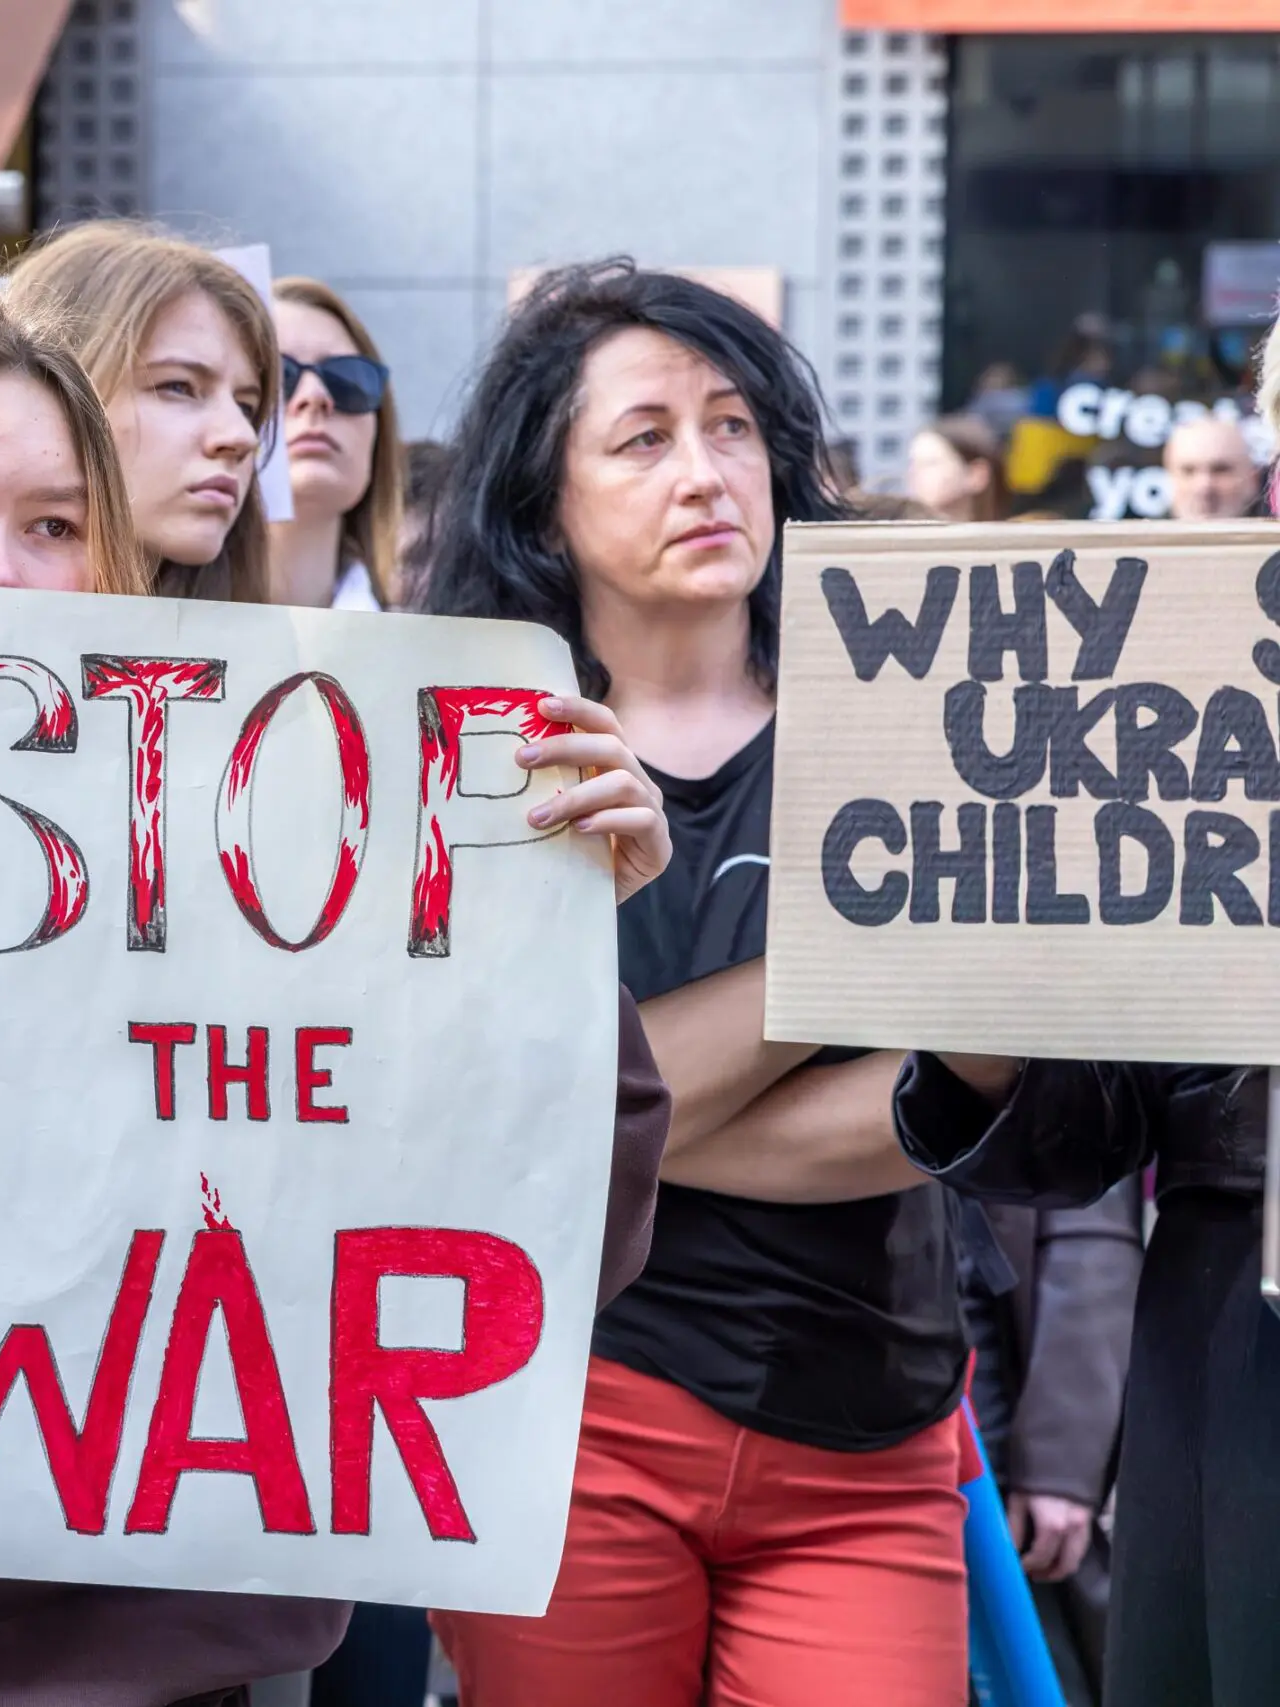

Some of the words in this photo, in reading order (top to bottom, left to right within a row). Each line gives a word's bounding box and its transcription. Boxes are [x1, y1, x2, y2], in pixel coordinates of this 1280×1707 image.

[821, 548, 1149, 681] WHY
[943, 679, 1280, 801] UKRA
[128, 1020, 352, 1124] THE
